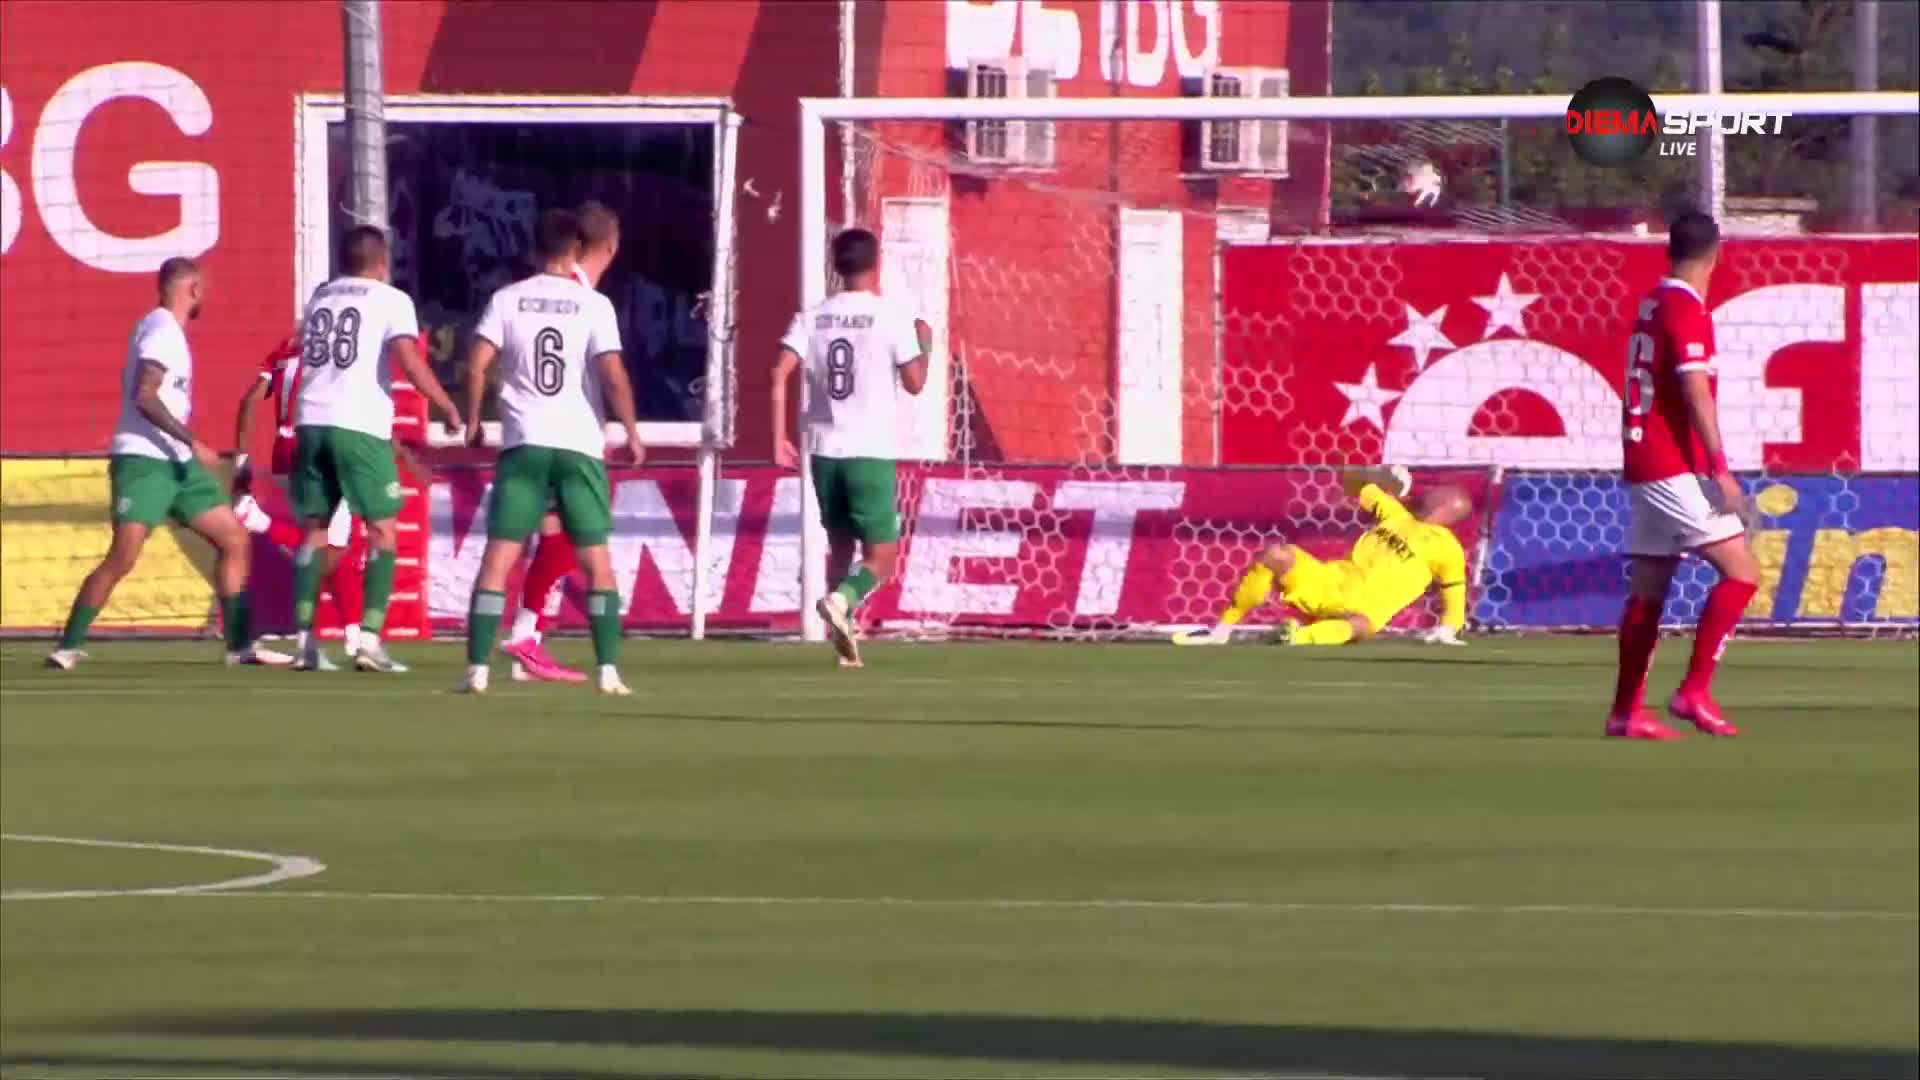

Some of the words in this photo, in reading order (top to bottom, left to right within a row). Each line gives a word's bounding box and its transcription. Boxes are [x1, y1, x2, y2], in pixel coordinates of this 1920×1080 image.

[0, 60, 220, 273] G
[534, 326, 566, 397] 6
[826, 337, 855, 401] 8
[1382, 283, 1919, 471] ef
